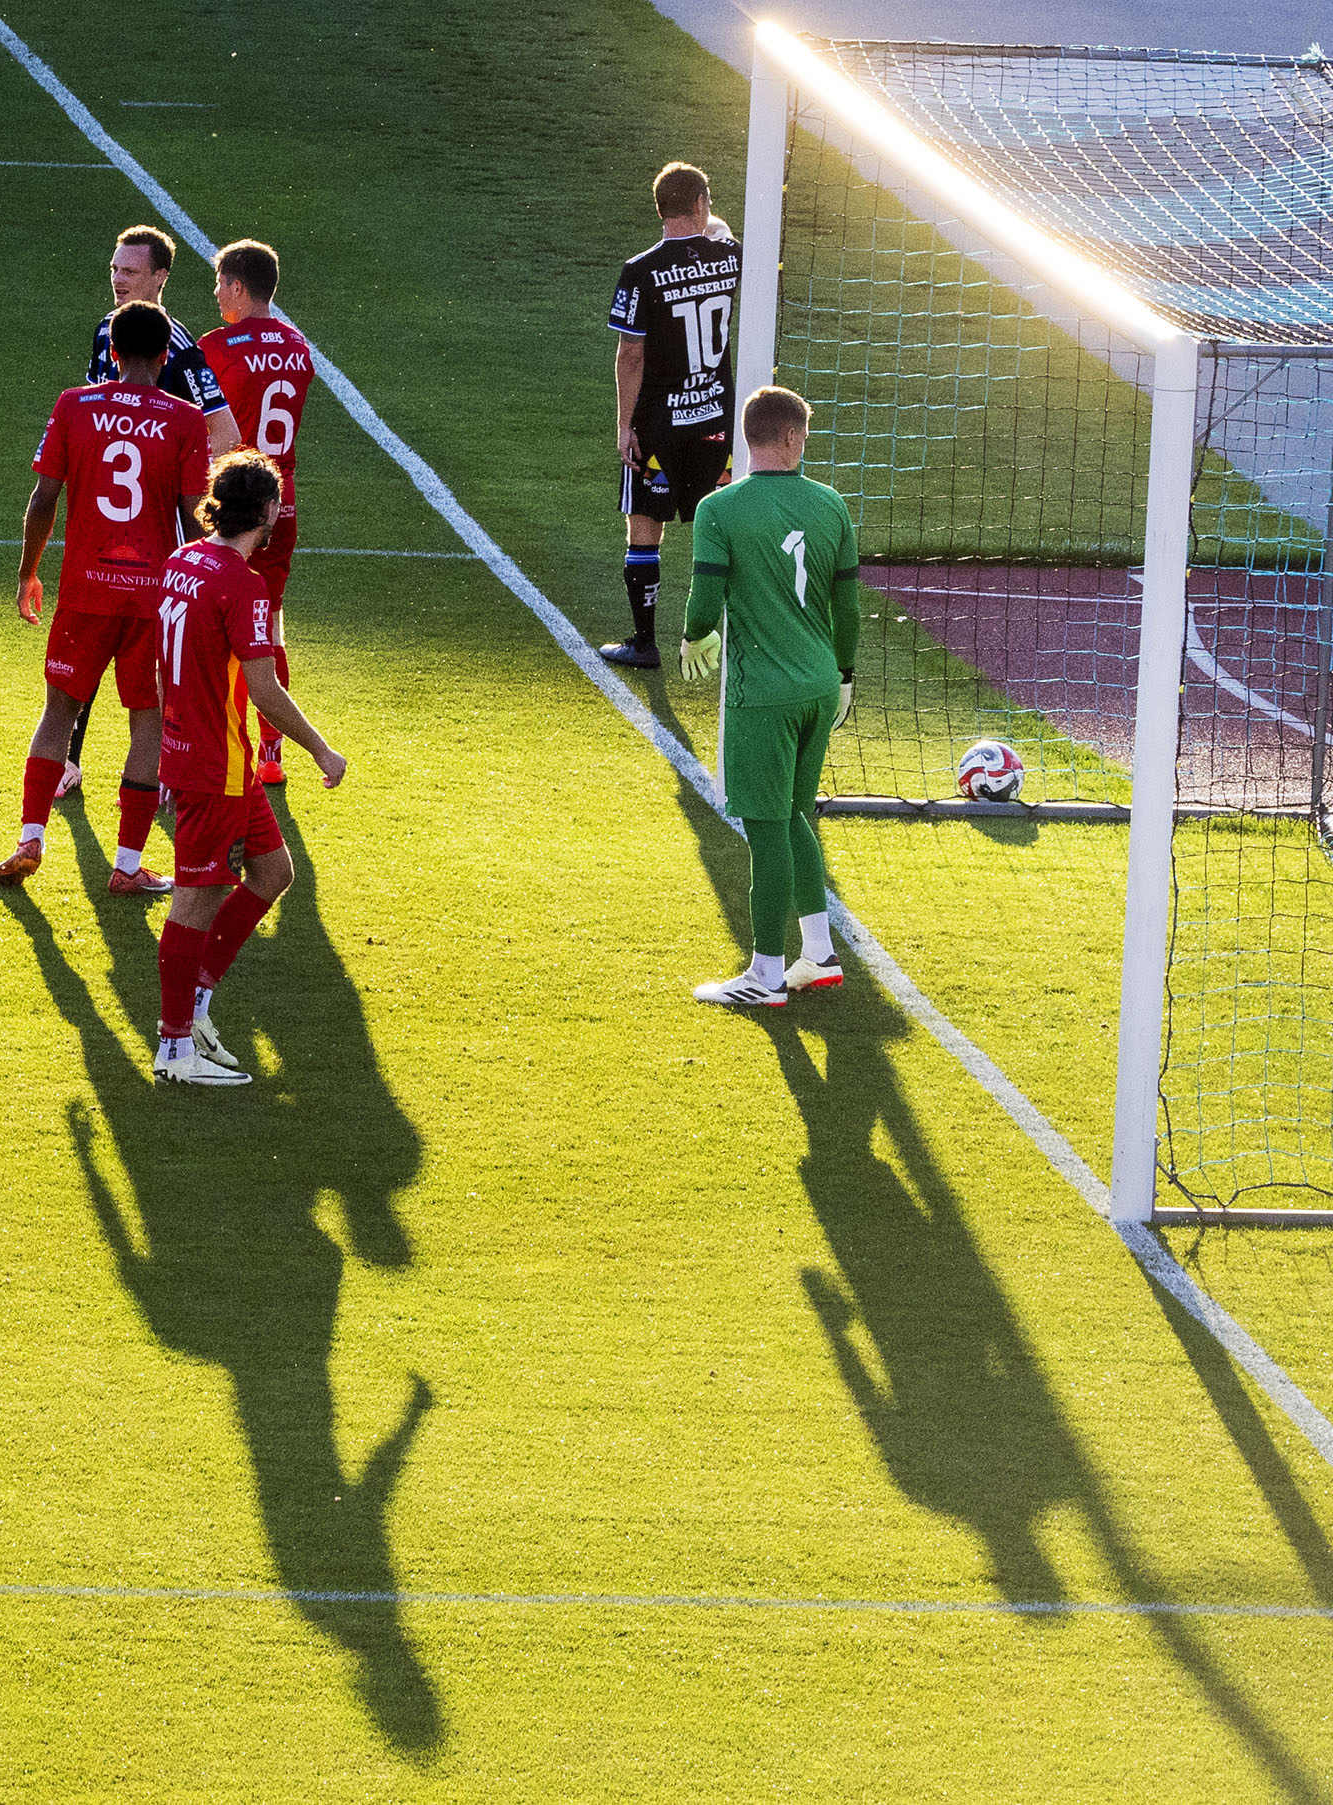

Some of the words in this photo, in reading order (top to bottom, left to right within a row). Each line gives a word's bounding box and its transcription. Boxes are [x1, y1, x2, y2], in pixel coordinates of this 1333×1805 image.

[650, 255, 739, 288] Infrakraft
[662, 277, 737, 303] BRASSERIET
[626, 286, 641, 326] stadium
[261, 332, 283, 341] OBK
[671, 294, 732, 375] 10
[112, 392, 142, 405] OBK
[184, 368, 205, 408] stadium
[256, 380, 297, 455] 6
[96, 440, 143, 522] 3
[85, 570, 159, 586] WALLENSTEDT
[781, 530, 808, 609] 1
[158, 596, 189, 686] 11
